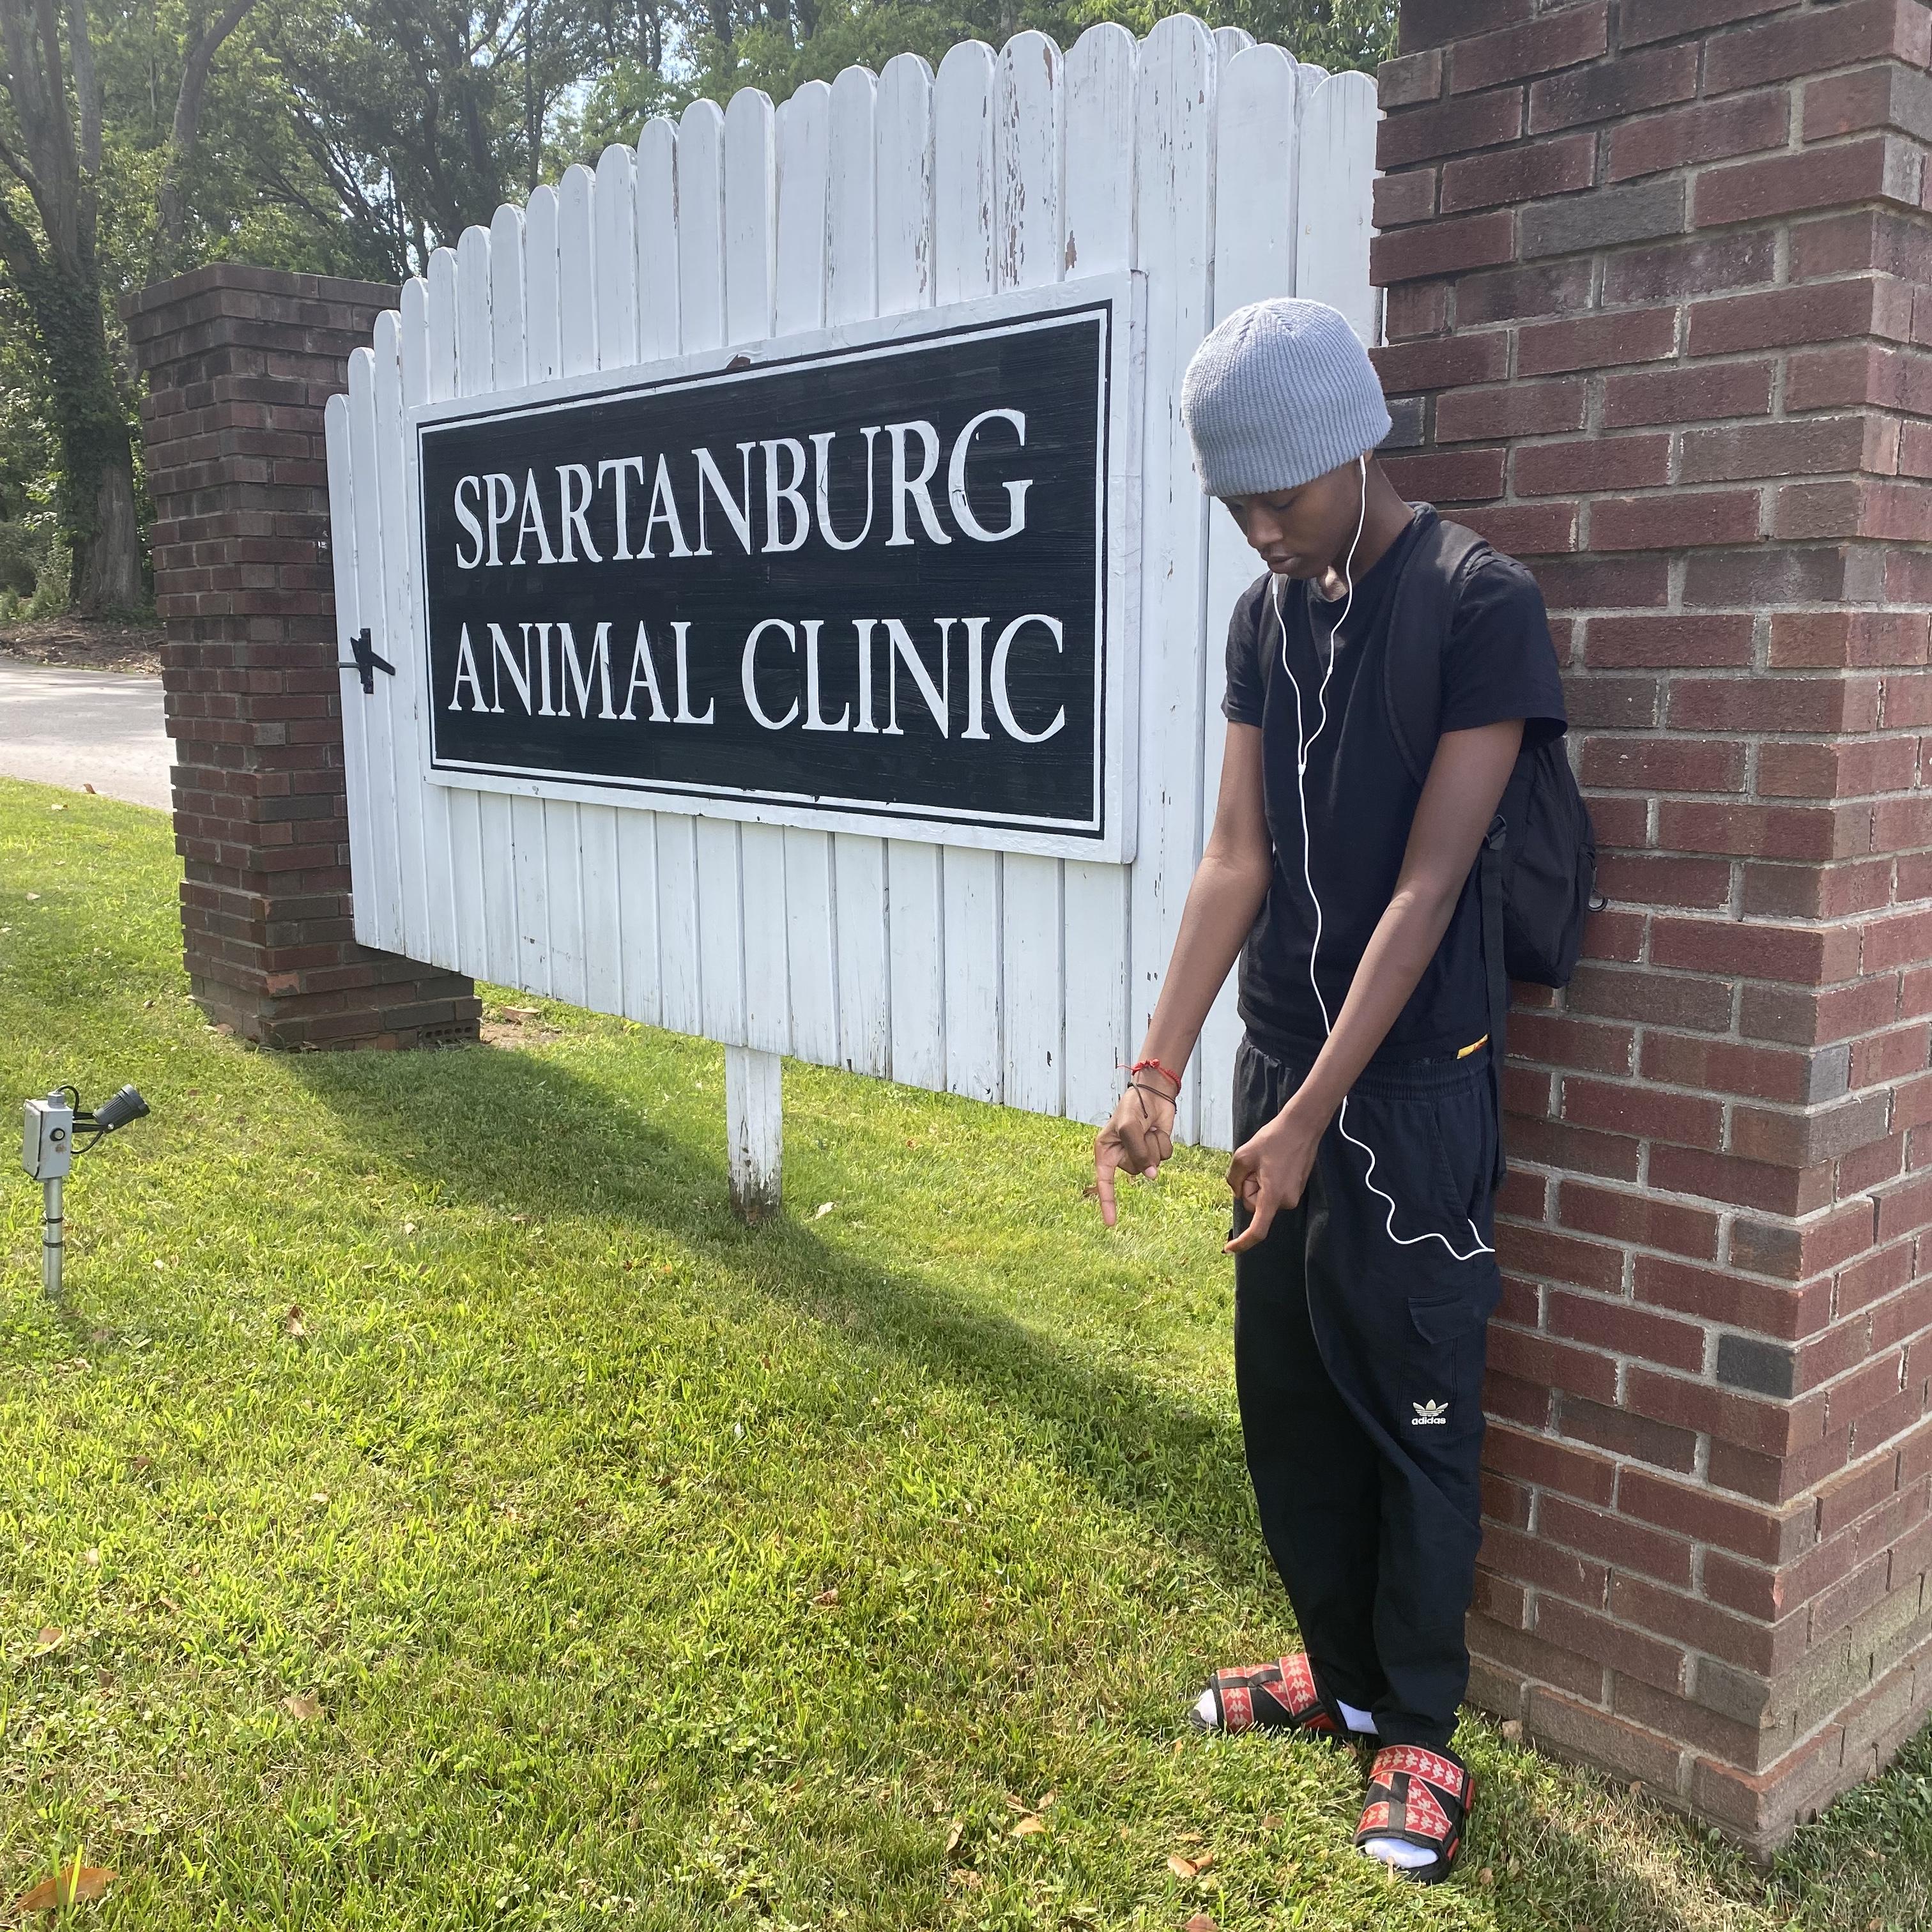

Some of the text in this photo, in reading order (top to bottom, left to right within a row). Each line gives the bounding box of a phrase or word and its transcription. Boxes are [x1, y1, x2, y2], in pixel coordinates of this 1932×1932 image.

[454, 408, 1034, 569] SPARTANBURG
[448, 614, 1065, 743] ANIMAL CLINIC
[1411, 1416, 1446, 1425] adidas
